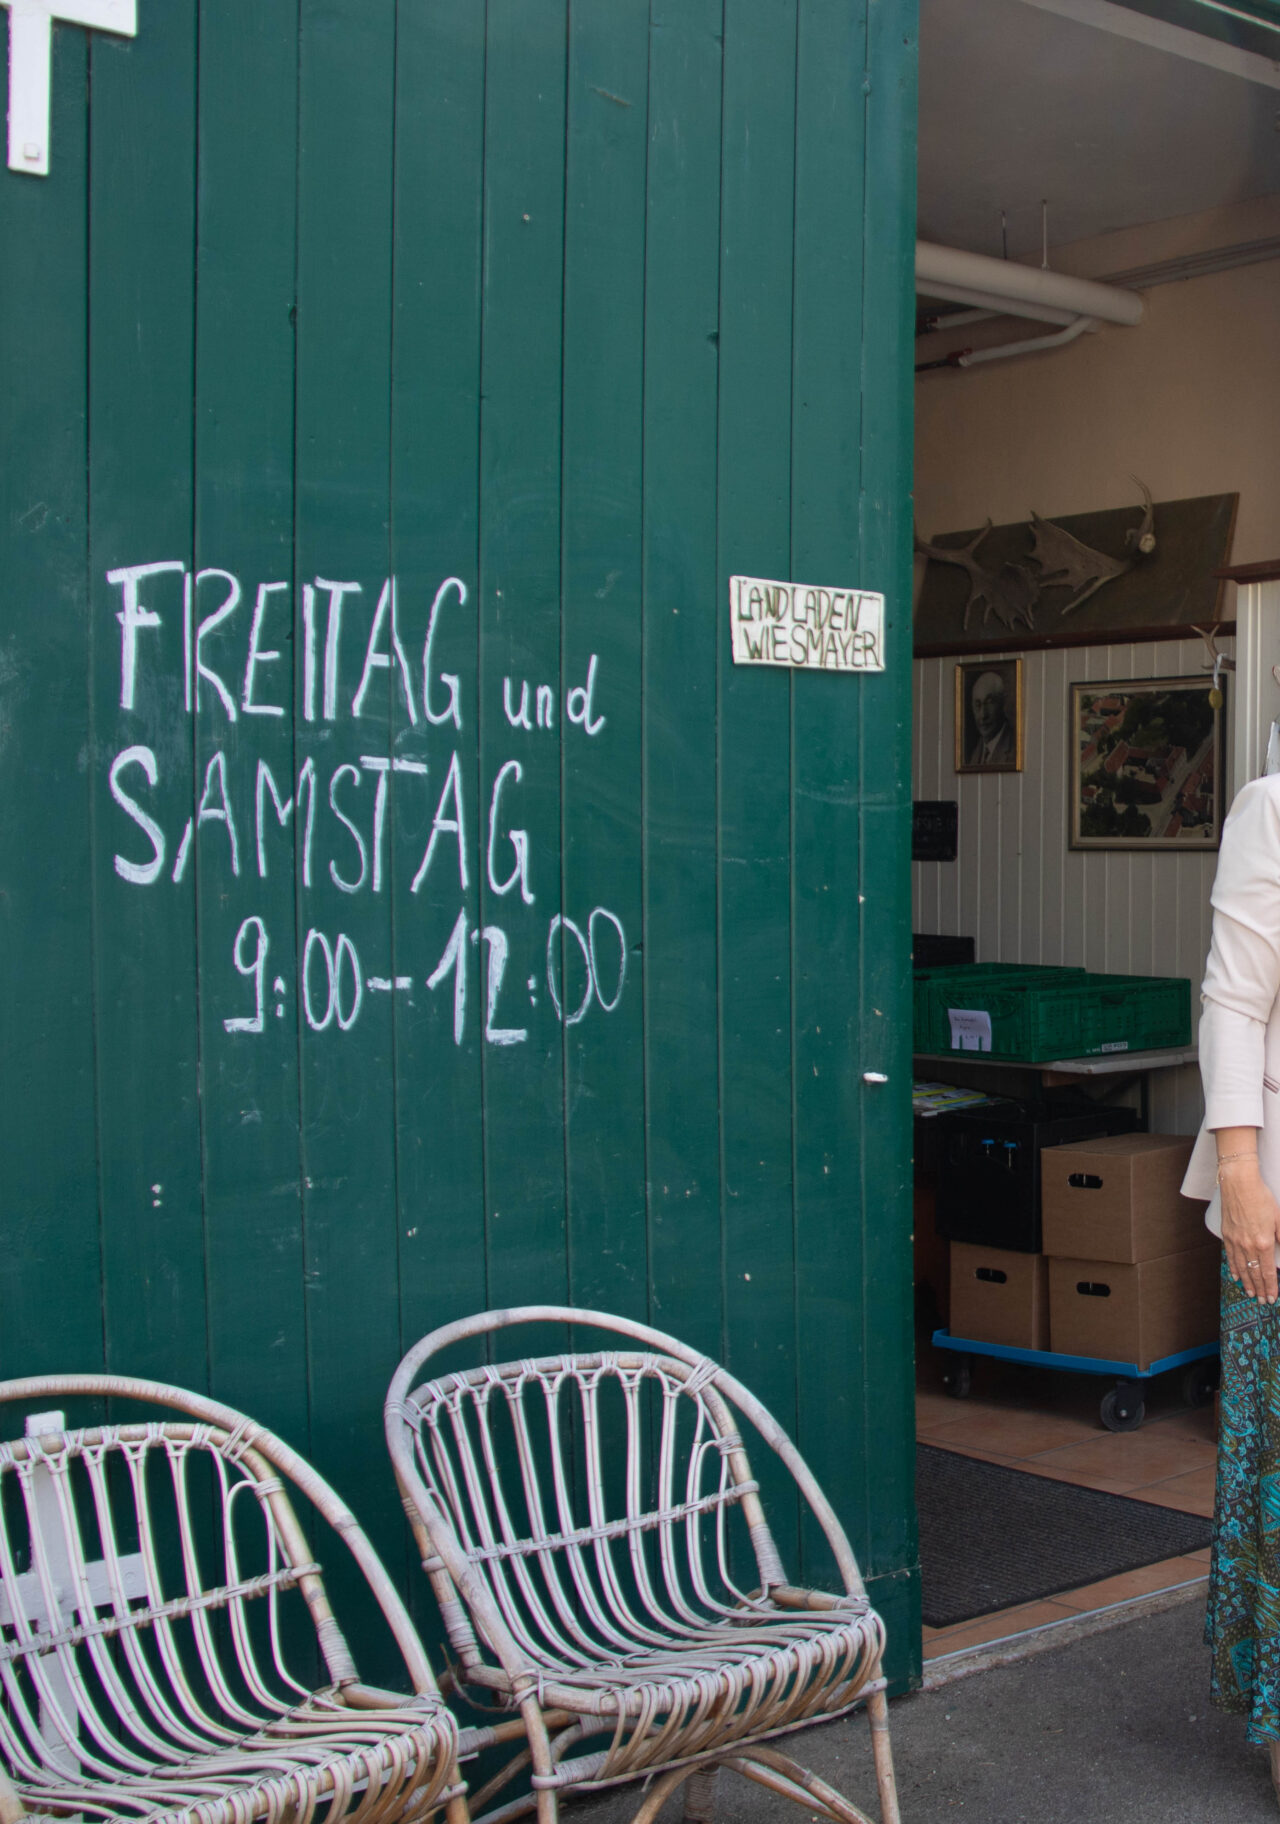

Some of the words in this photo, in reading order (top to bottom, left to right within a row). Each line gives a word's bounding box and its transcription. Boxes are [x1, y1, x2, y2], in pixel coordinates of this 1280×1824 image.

[106, 560, 467, 729] FREITAG
[503, 655, 605, 735] und
[738, 580, 863, 632] LANDLADEN
[744, 624, 880, 669] WIESMAYER
[109, 746, 534, 905] SAMSTAG
